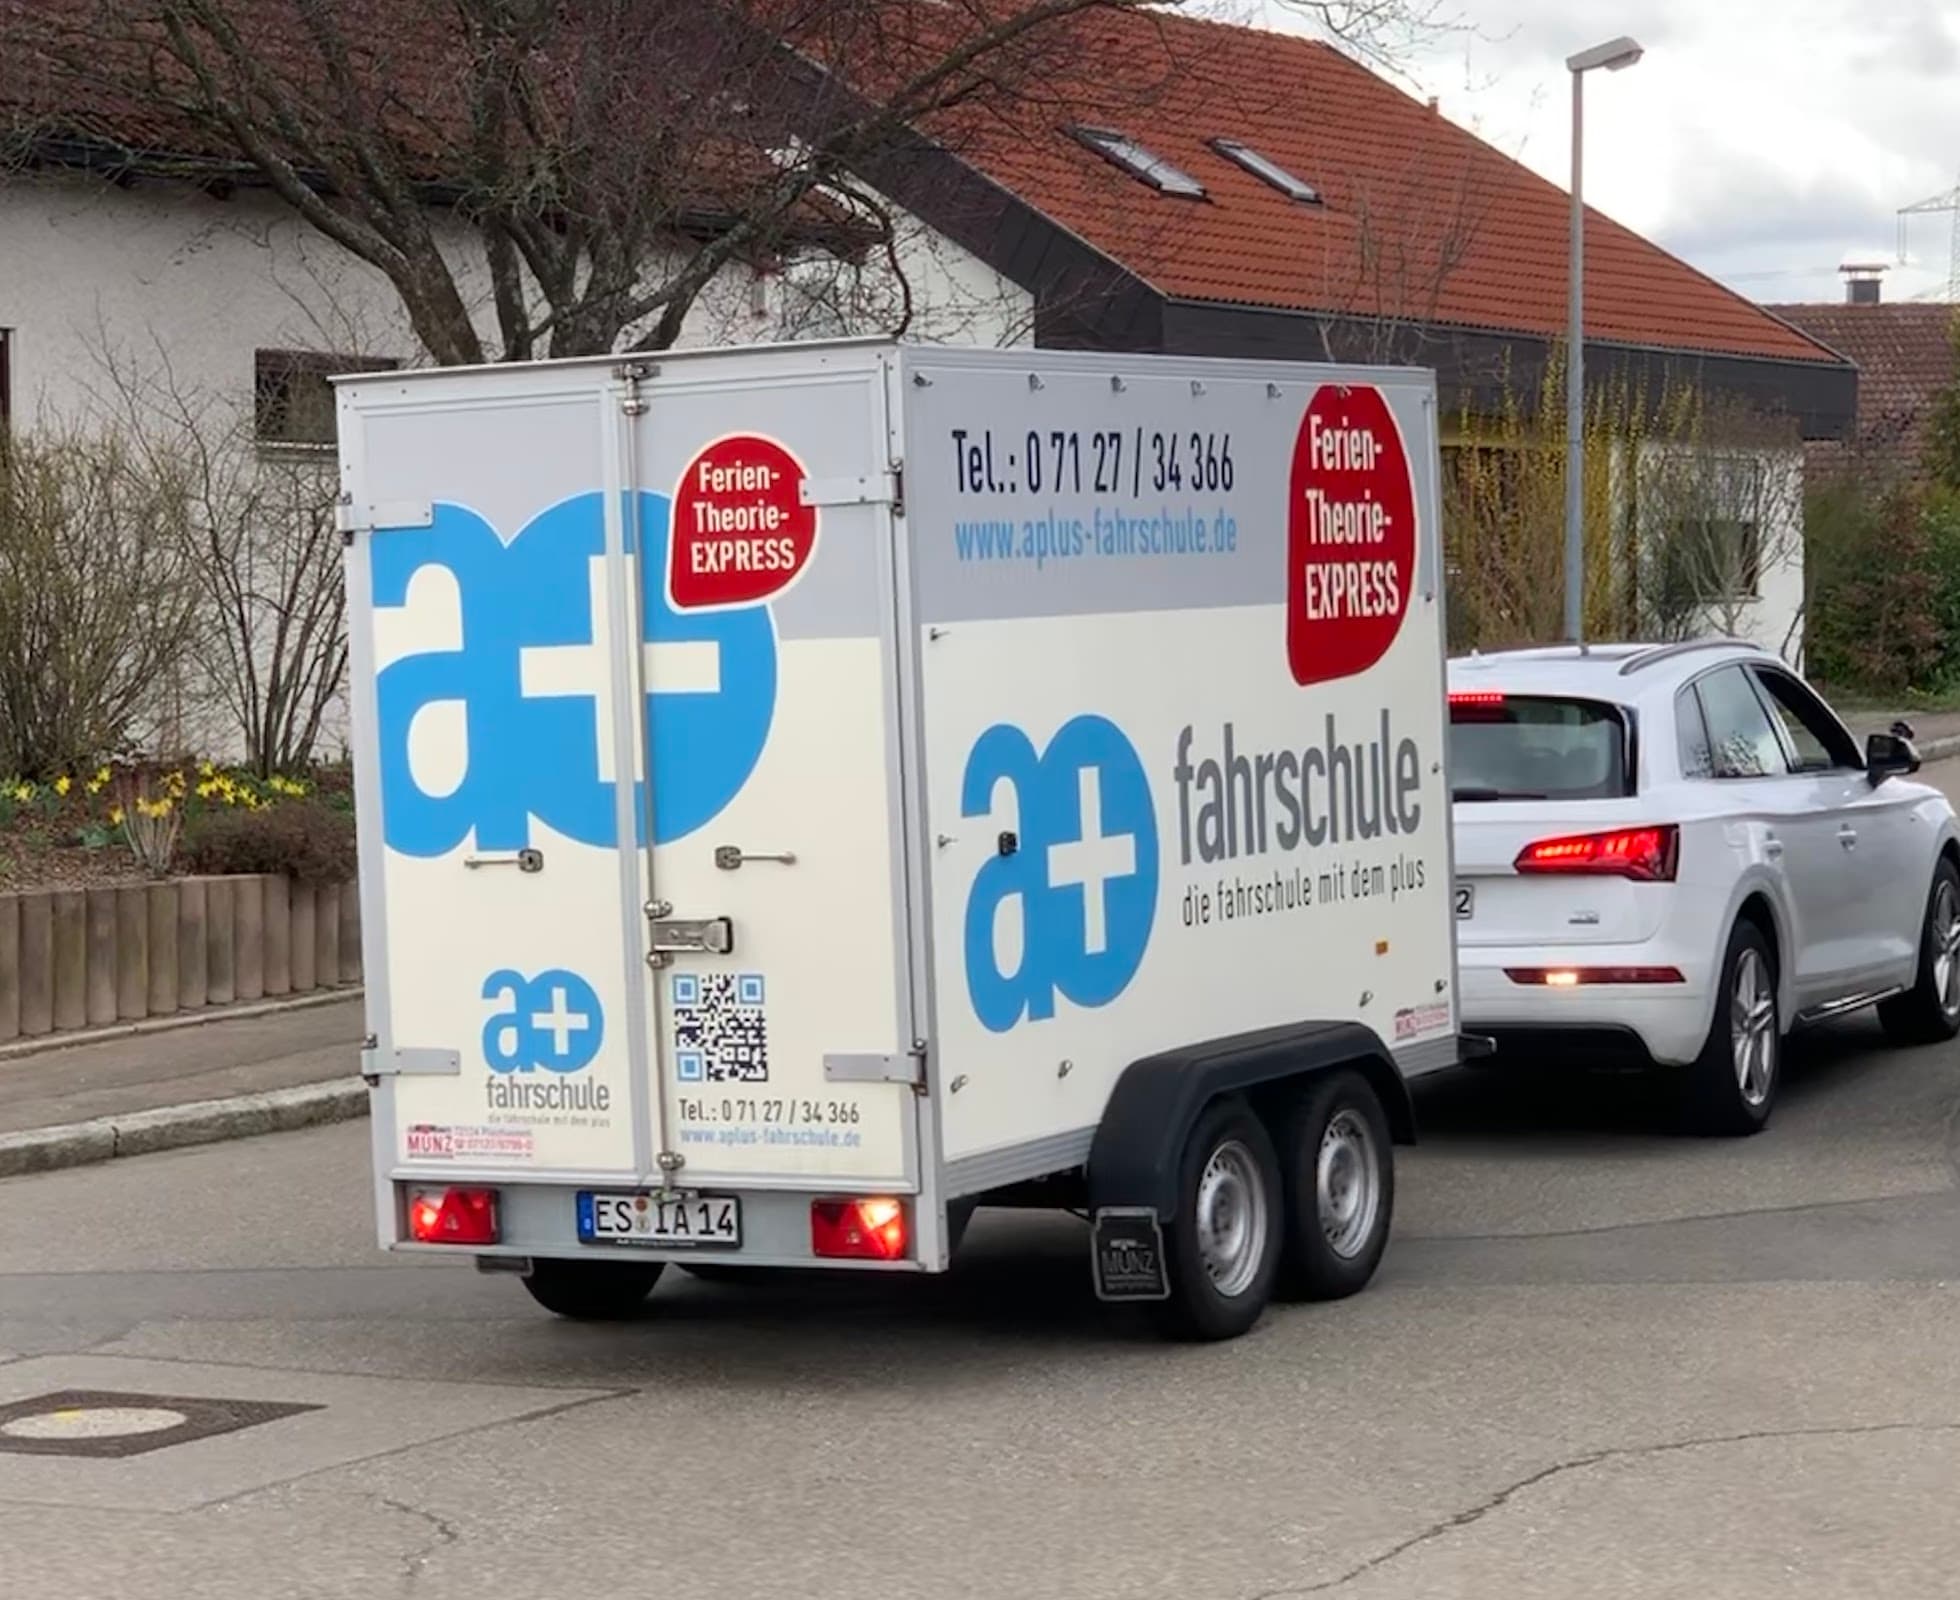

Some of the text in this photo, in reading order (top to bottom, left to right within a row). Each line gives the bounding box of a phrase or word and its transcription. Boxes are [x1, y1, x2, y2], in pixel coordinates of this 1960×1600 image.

[951, 427, 1234, 498] Tel.: 0 71 27 / 34 366
[1309, 414, 1384, 471] Ferien-
[699, 460, 780, 493] Ferien-
[692, 499, 790, 533] Theorie-
[955, 506, 1237, 571] www.aplus-fahrschule.de
[1305, 489, 1393, 545] Theorie-
[689, 537, 796, 574] EXPRESS
[1305, 561, 1400, 620] EXPRESS
[1174, 708, 1421, 866] fahrschule
[1182, 853, 1425, 926] die fahrschule mit dem plus
[486, 1075, 611, 1111] fahrschule
[679, 1099, 860, 1125] Tel.: 0 71 27 / 34 366
[680, 1127, 861, 1147] www.aplus-fahrschule.de
[597, 1201, 733, 1236] ES IA 14
